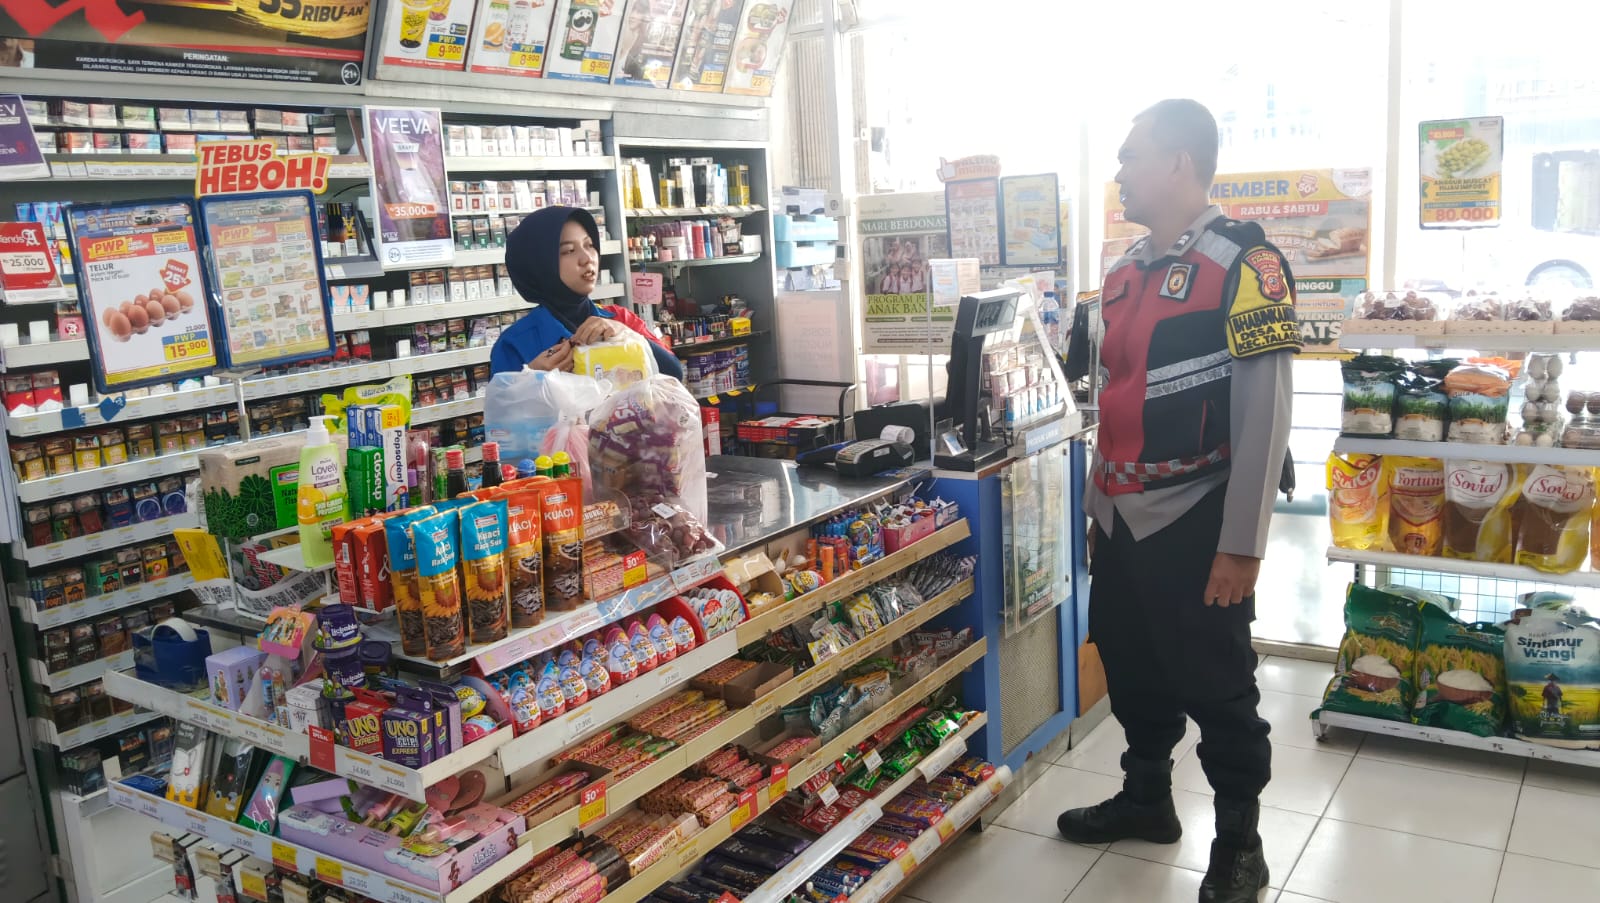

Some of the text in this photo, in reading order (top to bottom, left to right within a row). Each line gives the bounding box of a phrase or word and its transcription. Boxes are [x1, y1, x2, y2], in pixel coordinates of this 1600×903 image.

[375, 117, 432, 135] VEEVA
[201, 143, 272, 165] TEBUS
[199, 151, 327, 194] HEBOH!
[1240, 206, 1272, 217] RABU
[1284, 203, 1320, 213] SABTU
[1436, 207, 1494, 222] 80.000
[862, 221, 888, 232] MARI
[9, 258, 44, 267] 25.000
[89, 262, 114, 272] TELUR
[868, 303, 902, 315] ANAK
[1240, 326, 1275, 341] DESA
[311, 463, 338, 476] Lovely
[373, 452, 383, 501] closeup
[1453, 472, 1496, 494] Sovia
[544, 508, 574, 521] KUACI
[1517, 637, 1584, 649] Sintanur
[1523, 647, 1576, 662] Wangi
[348, 713, 380, 740] UNO
[385, 719, 418, 739] UNO
[354, 735, 380, 747] EXPRESS
[391, 747, 419, 755] EXPRESS
